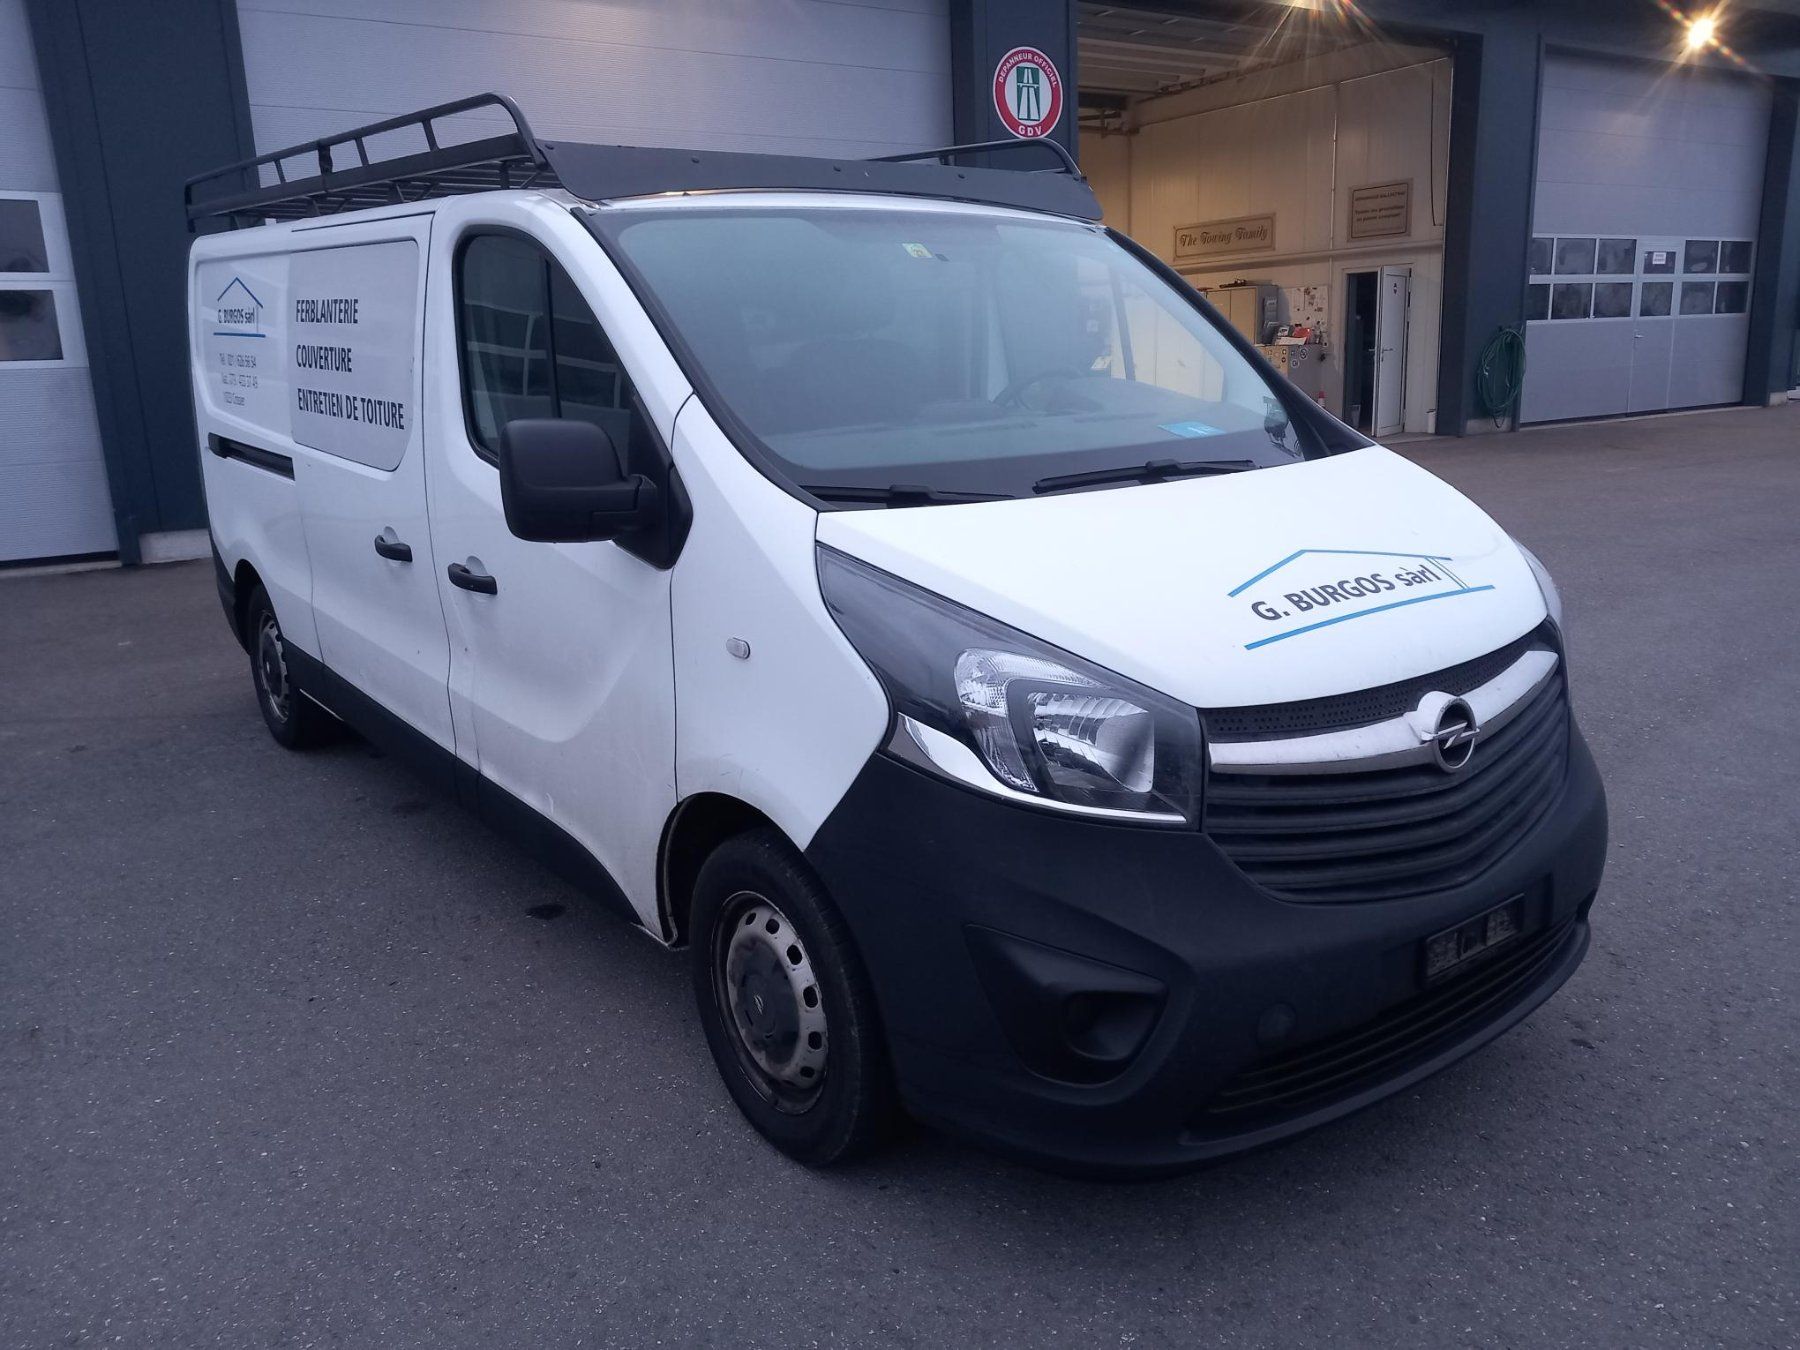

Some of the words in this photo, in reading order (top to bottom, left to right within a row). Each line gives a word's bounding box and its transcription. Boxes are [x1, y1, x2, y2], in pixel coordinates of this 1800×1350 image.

[998, 52, 1033, 83] DEPANNEUR
[1034, 55, 1058, 88] OFFICIEL
[1018, 125, 1042, 136] GDV
[1179, 233, 1197, 247] The
[1200, 231, 1233, 245] Towing
[1235, 225, 1268, 241] Family
[296, 299, 359, 324] FERBLANTERIE
[296, 344, 353, 373] COUVERTURE
[297, 388, 343, 418] ENTRETIEN
[345, 394, 359, 421] DE
[360, 397, 405, 430] TOITURE
[1250, 600, 1291, 621] G.
[1283, 573, 1397, 613] BURGOS
[1394, 564, 1443, 588] sàrl
